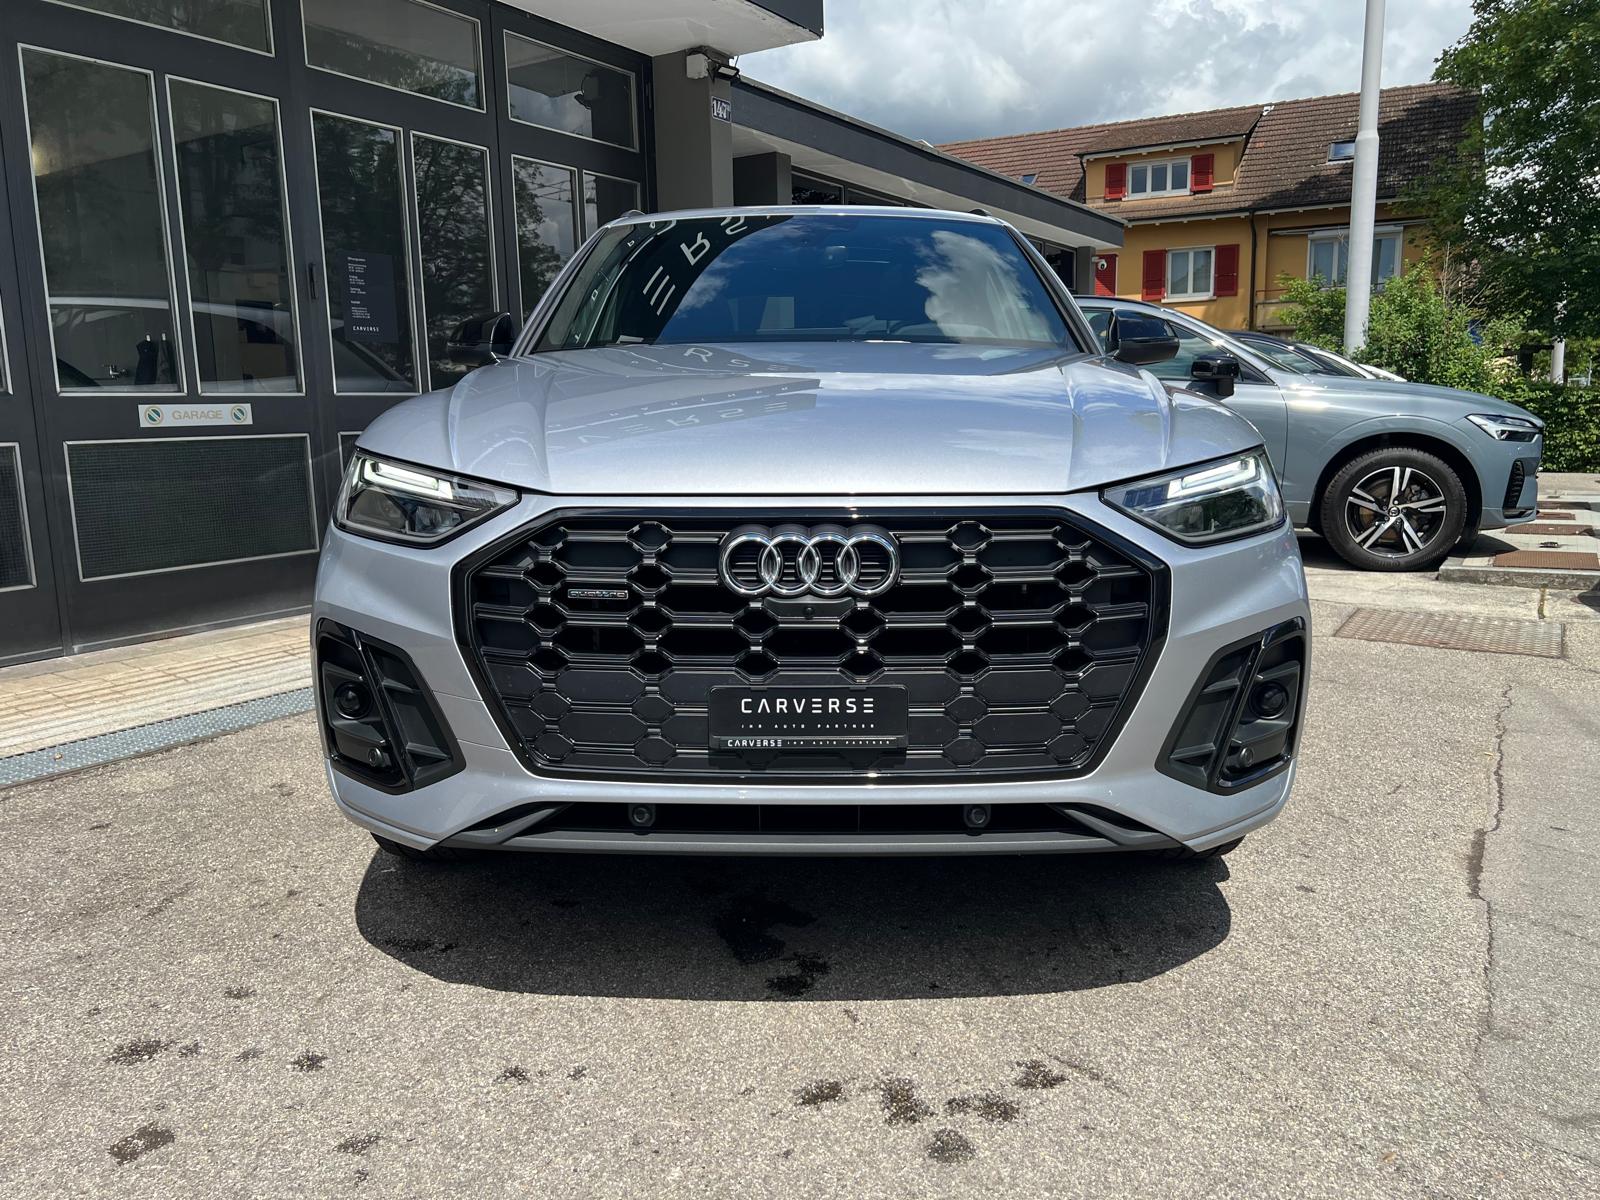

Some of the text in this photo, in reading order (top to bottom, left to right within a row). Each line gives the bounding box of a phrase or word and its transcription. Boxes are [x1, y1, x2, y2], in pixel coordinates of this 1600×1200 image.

[171, 410, 223, 420] GARAGE
[570, 590, 626, 598] quattro
[741, 698, 874, 714] CARVERSE
[727, 739, 782, 747] CARVERSE
